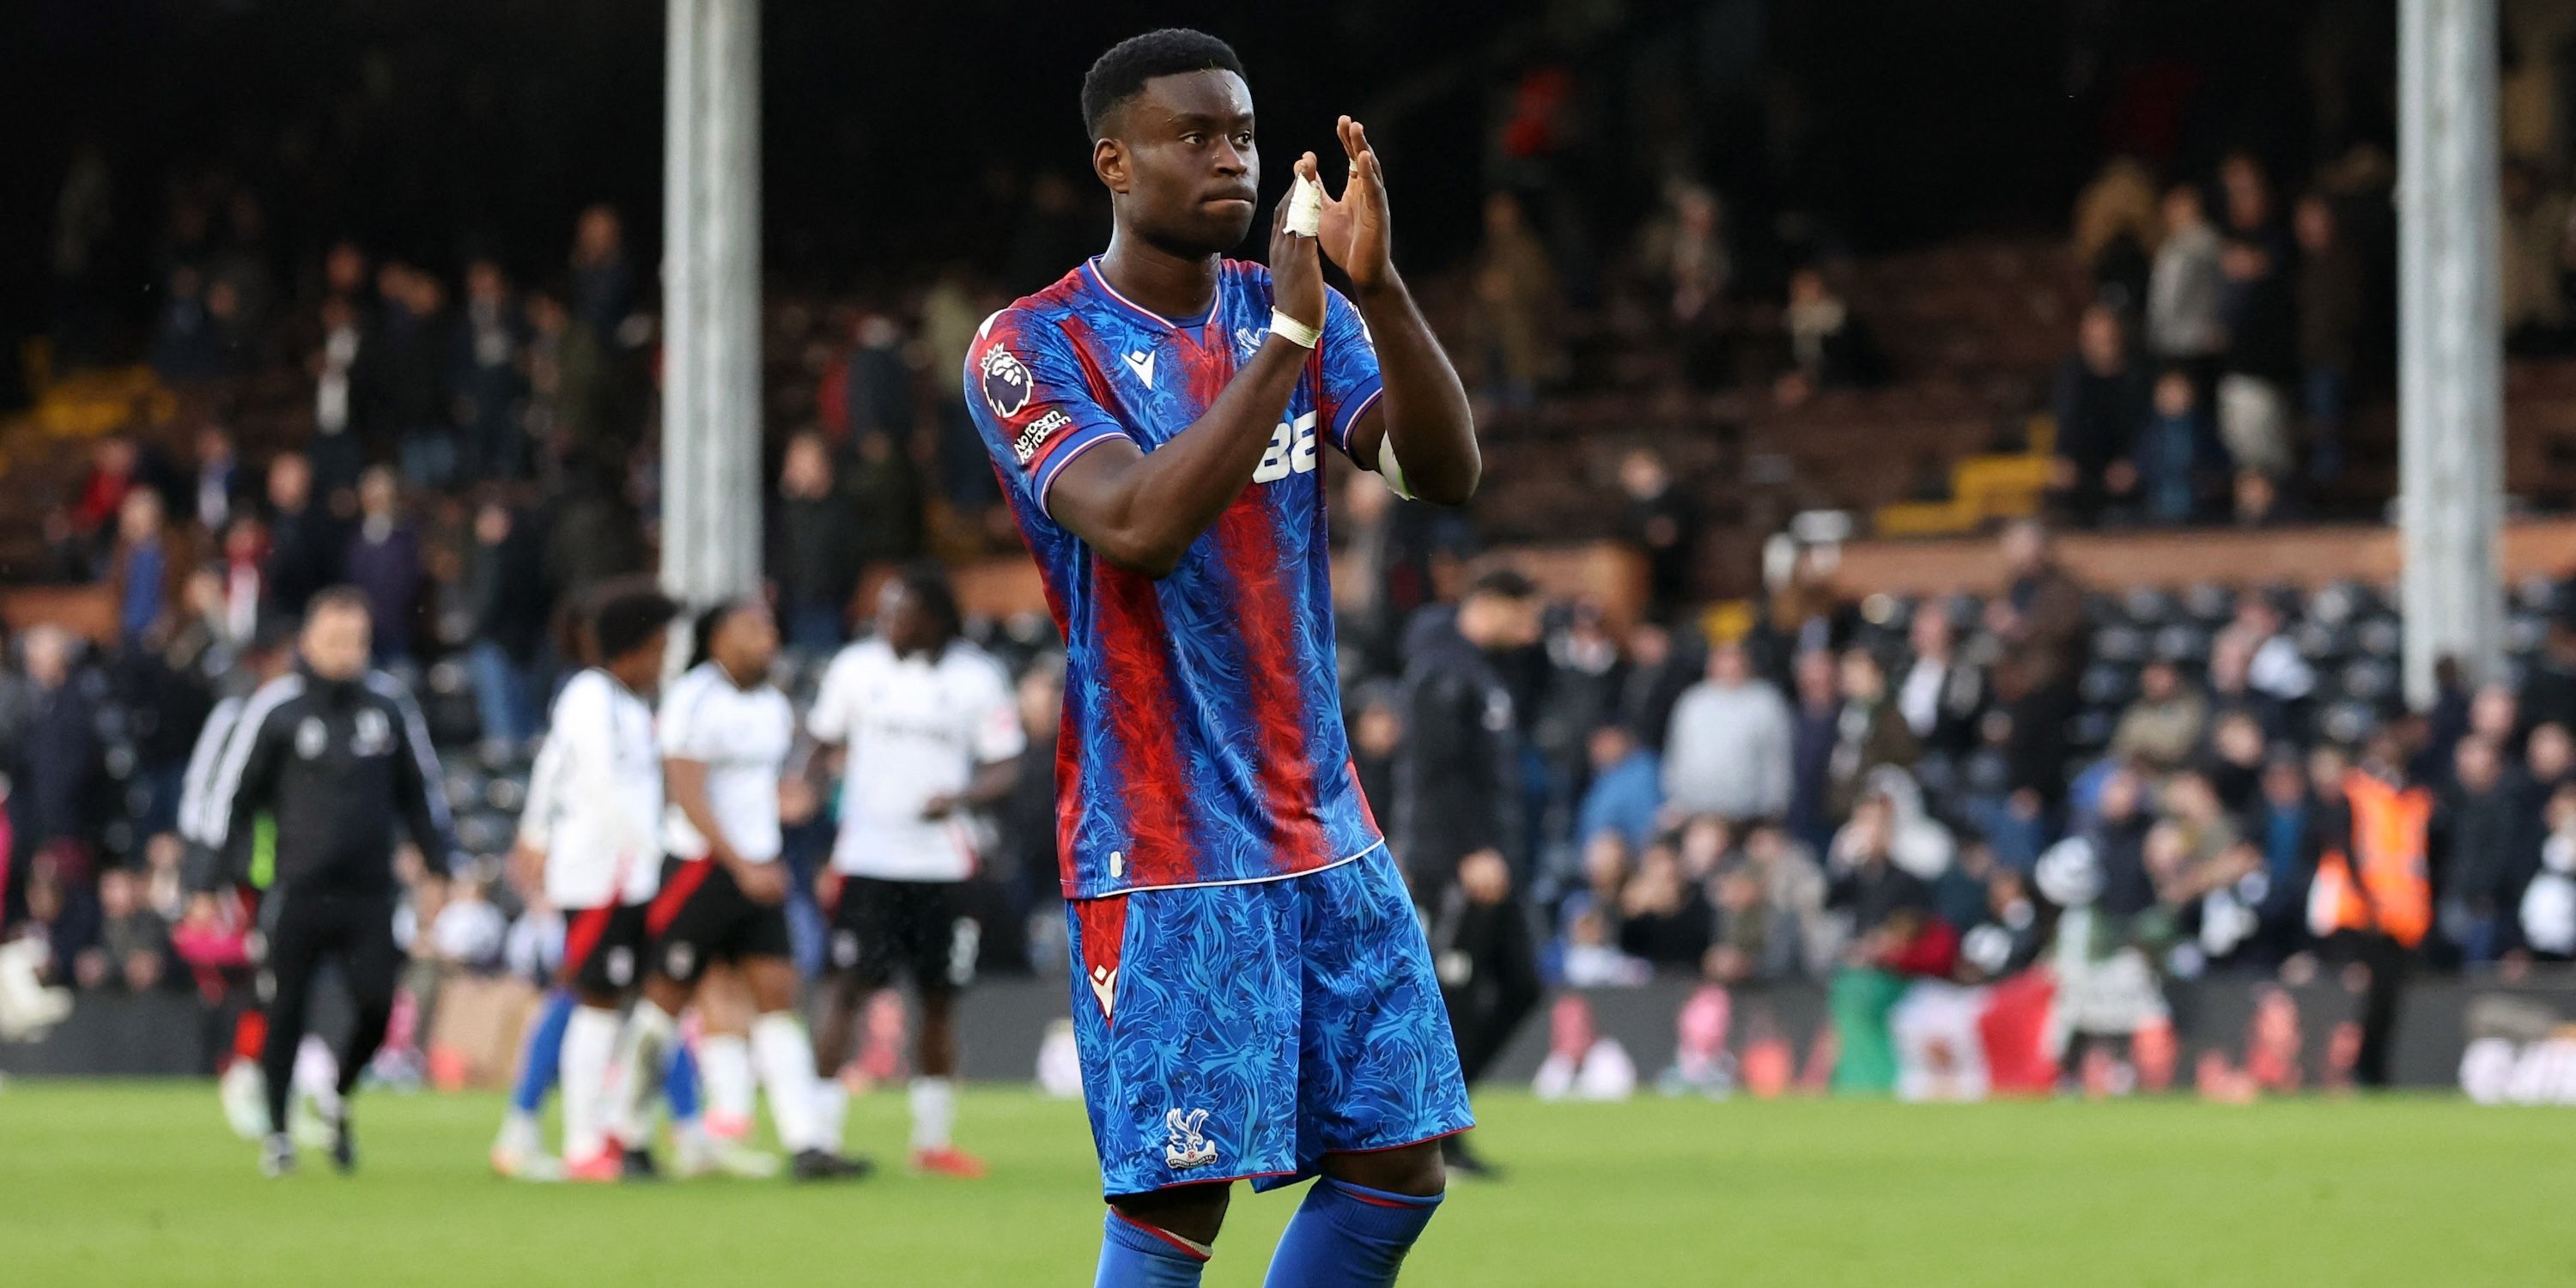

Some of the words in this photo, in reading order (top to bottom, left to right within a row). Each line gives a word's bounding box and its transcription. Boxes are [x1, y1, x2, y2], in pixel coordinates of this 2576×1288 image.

[1014, 434, 1029, 456] No
[1024, 410, 1060, 439] room
[1031, 416, 1072, 448] racism
